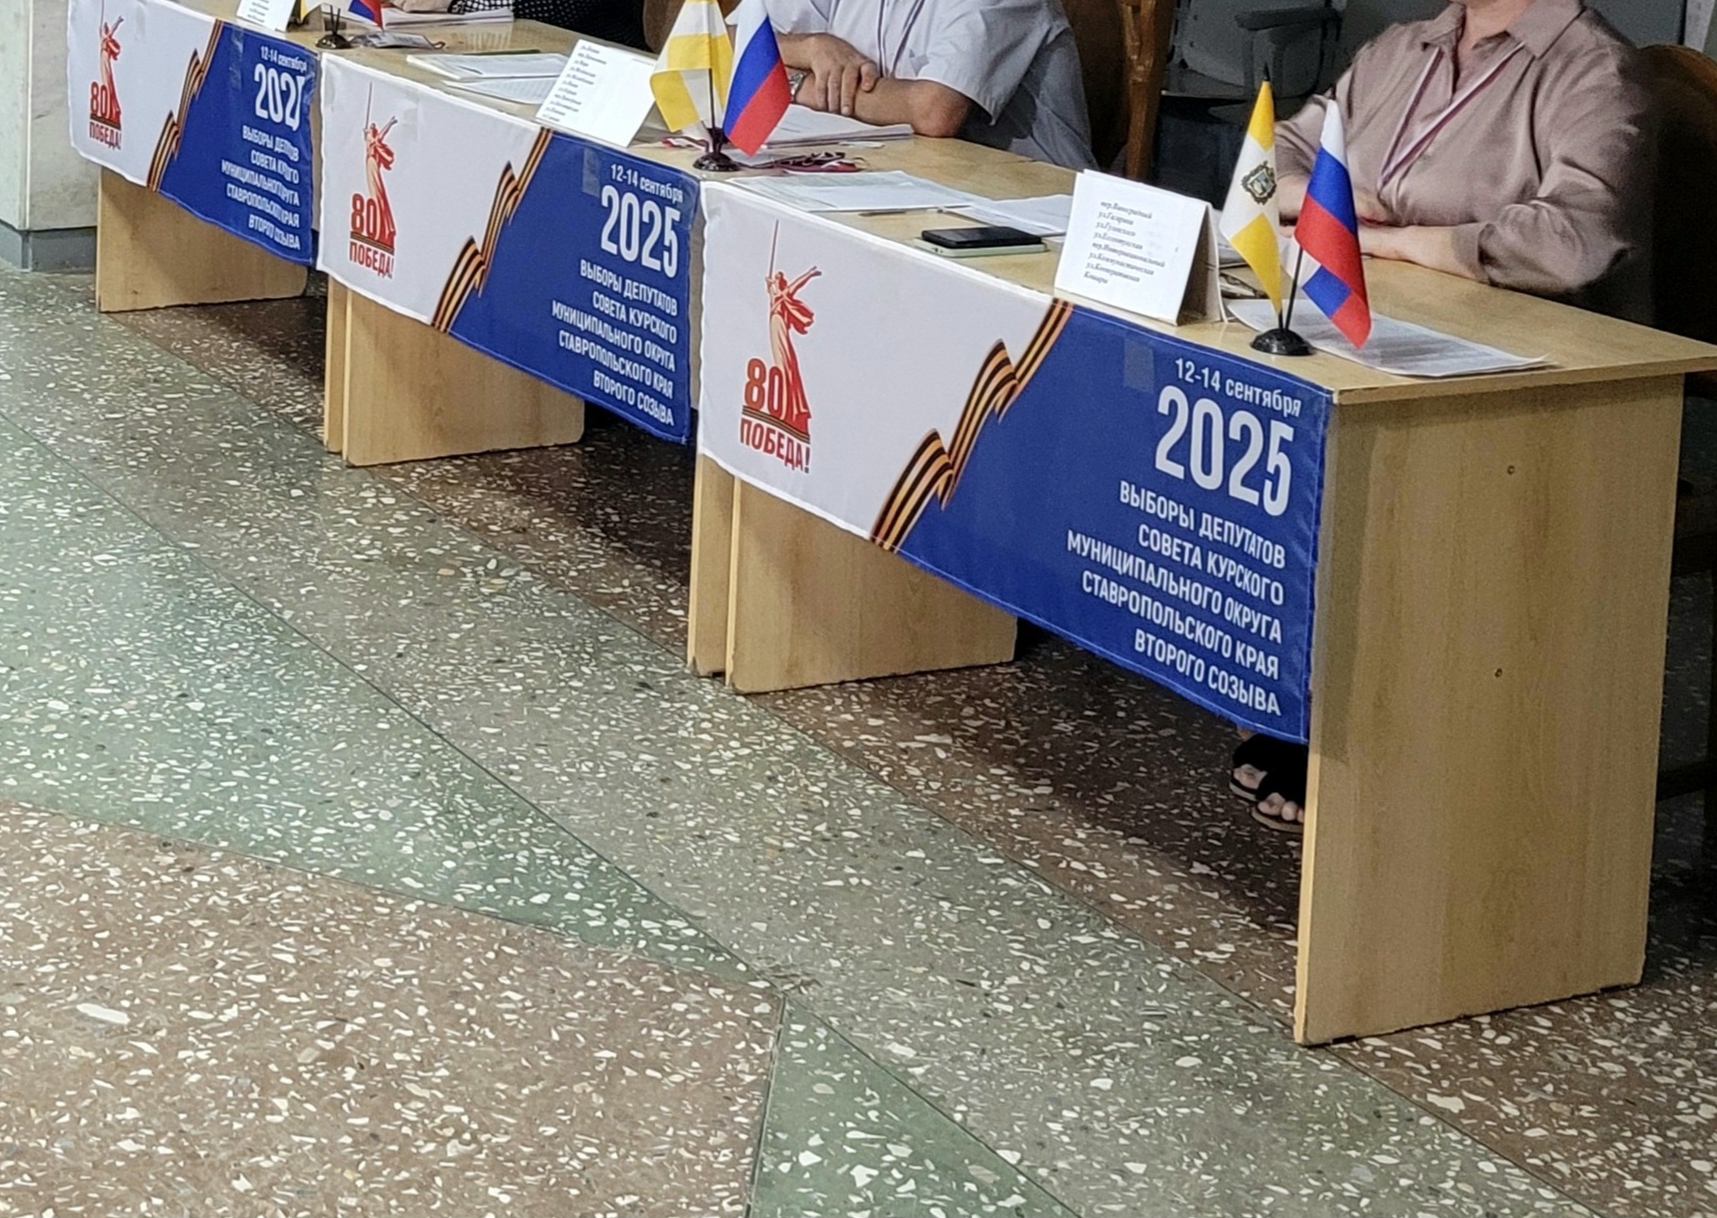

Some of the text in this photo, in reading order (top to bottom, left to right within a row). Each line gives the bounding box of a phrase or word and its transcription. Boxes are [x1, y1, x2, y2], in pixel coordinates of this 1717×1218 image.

[261, 46, 278, 63] 12-14
[90, 81, 108, 117] 80
[89, 122, 122, 150] ПОБЕДА!
[242, 124, 273, 148] ВЫБОРЫ
[251, 149, 276, 172] СОВЕТА
[611, 163, 683, 204] 12-14 сентября
[351, 193, 377, 239] 80
[601, 184, 681, 278] 2025
[349, 241, 394, 279] ПОБЕДА!
[580, 259, 677, 316] ВЫБОРЫ ДЕПУТАТОВ
[552, 300, 675, 372] МУНИЦИПАЛЬНОГО ОКРУГА
[593, 291, 677, 344] СОВЕТА КУРСКОГО
[559, 330, 673, 399] СТАВРОПОЛЬСКОГО КРАЯ
[744, 358, 783, 419] 80
[1175, 357, 1301, 418] 12-14 сентября
[593, 370, 674, 426] ВТОРОГО СОЗЫВА
[740, 417, 810, 474] ПОБЕДА!
[1155, 385, 1294, 516] 2025
[1119, 480, 1286, 569] ВЫБОРЫ ДЕПУТАТОВ
[1067, 529, 1282, 644] МУНИЦИПАЛЬНОГО ОКРУГА
[1138, 523, 1284, 606] СОВЕТА КУРСКОГО
[1082, 570, 1279, 680] СТАВРОПОЛЬСКОГО КРАЯ
[1134, 628, 1282, 716] ВТОРОГО СОЗЫВА
